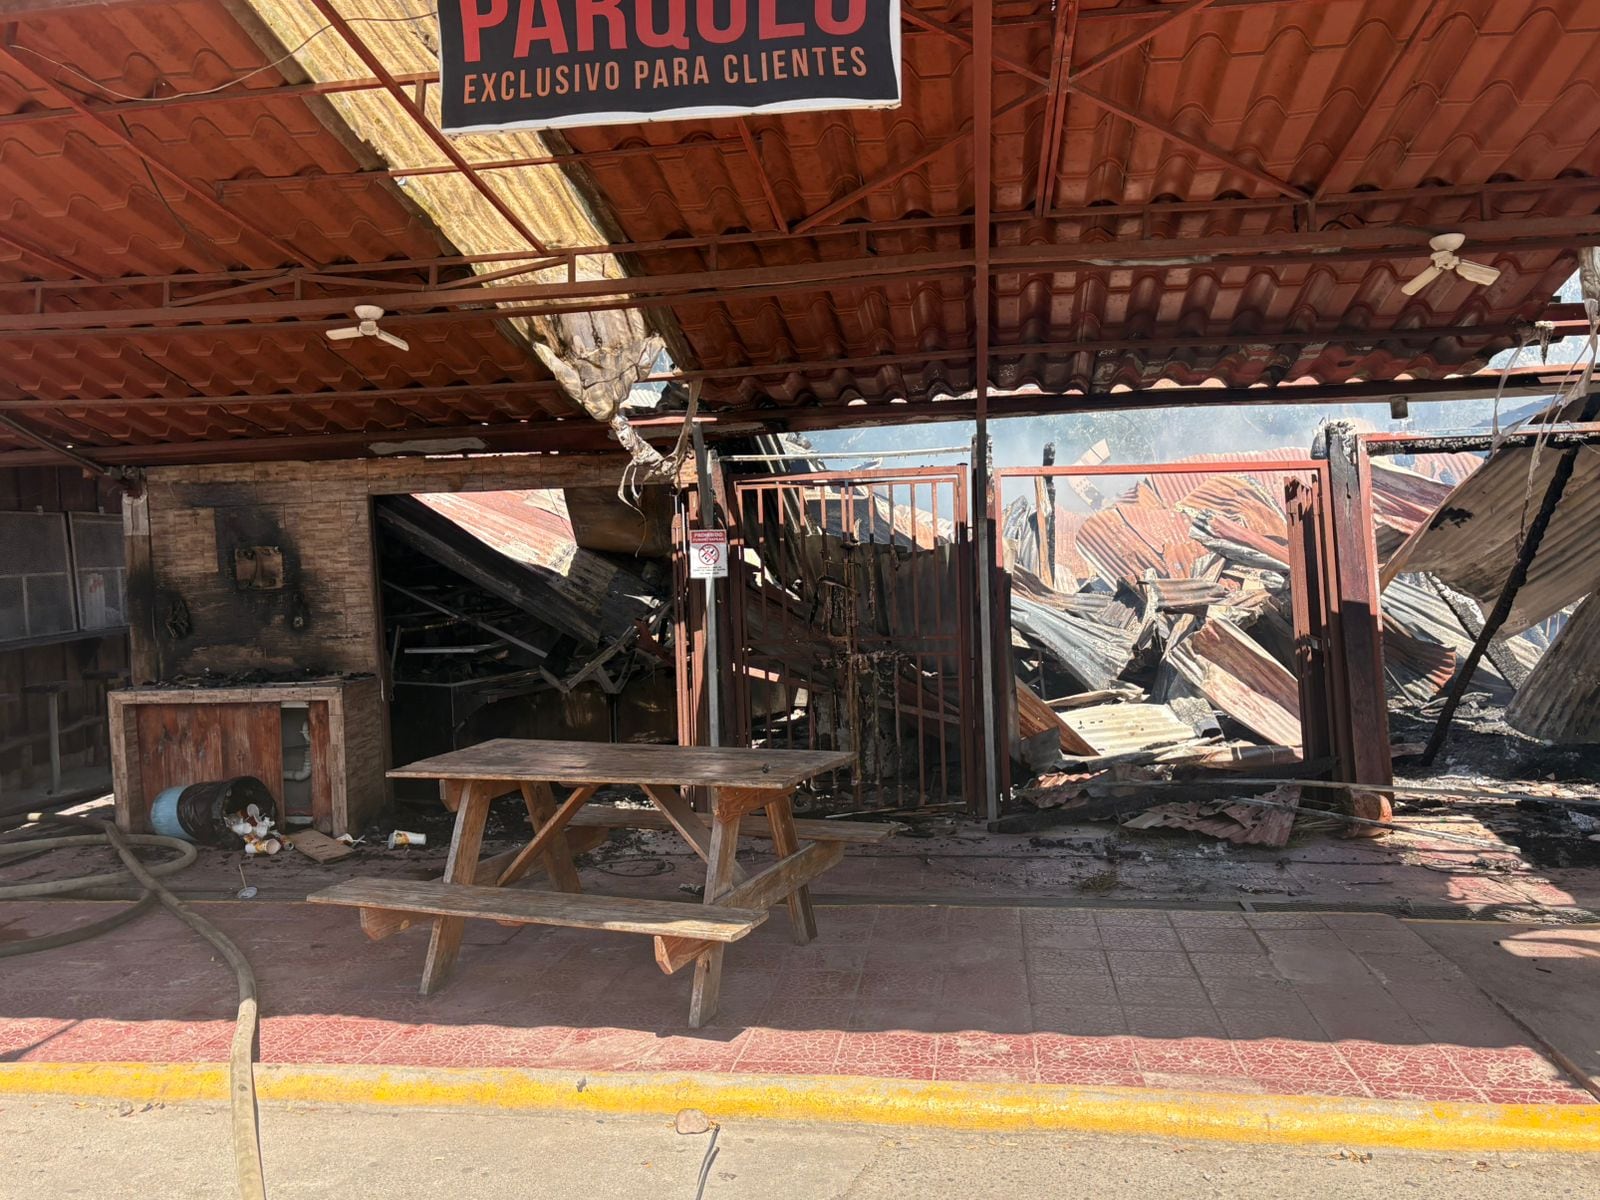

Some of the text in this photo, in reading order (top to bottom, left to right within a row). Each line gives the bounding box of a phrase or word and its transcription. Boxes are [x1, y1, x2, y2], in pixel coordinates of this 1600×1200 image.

[463, 46, 867, 104] EXCLUSIVO PARA CLIENTES
